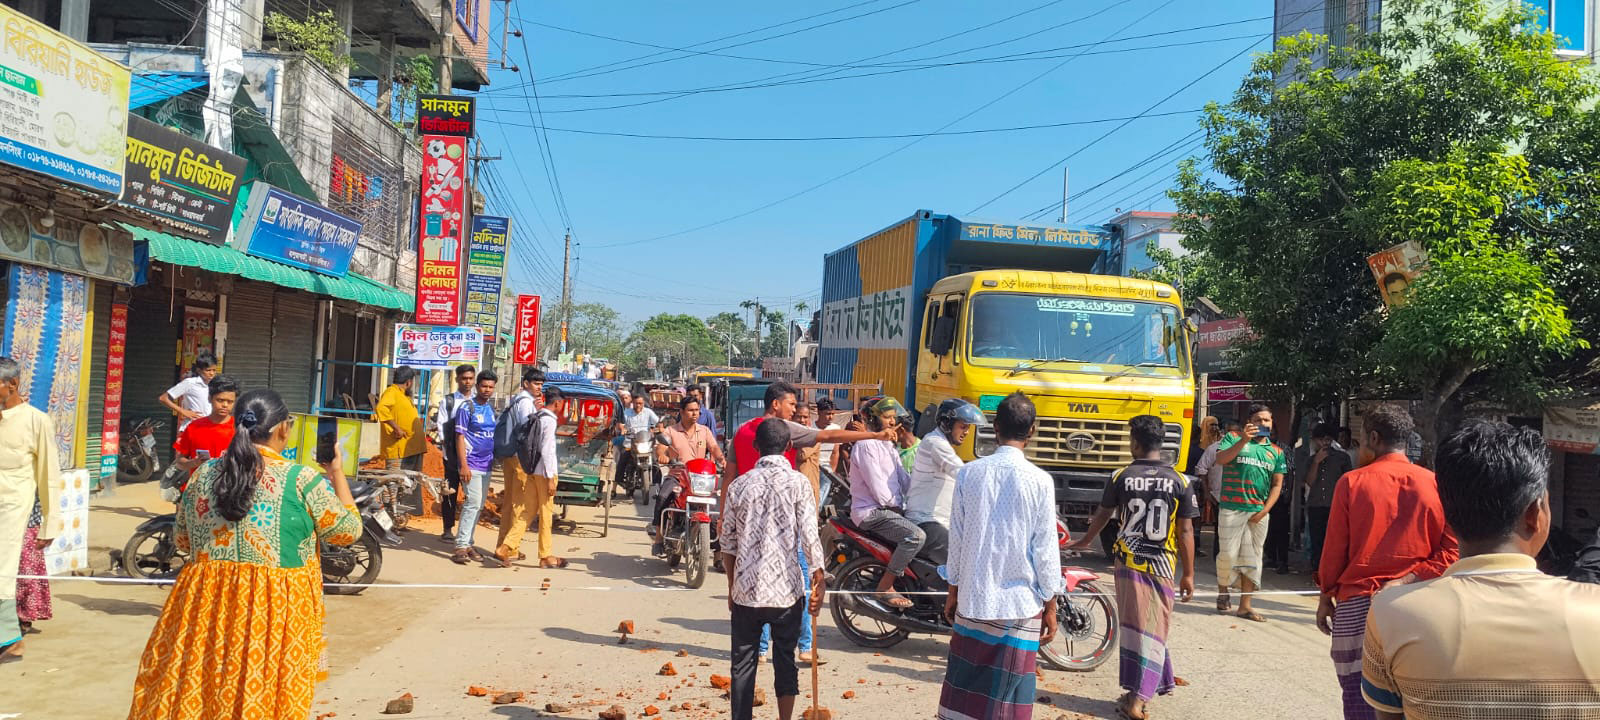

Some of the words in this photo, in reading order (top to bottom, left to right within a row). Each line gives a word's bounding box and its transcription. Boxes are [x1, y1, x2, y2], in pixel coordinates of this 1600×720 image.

[421, 98, 470, 116] সানমুন
[421, 115, 470, 132] ডিজিটাল
[125, 135, 177, 184] সানমুন
[175, 147, 237, 195] ডিজিটাল
[473, 228, 506, 245] মদিনা
[968, 225, 990, 238] রানা
[992, 224, 1013, 240] ফিড
[1045, 227, 1100, 246] লিমিটেড
[423, 260, 456, 276] লিমন
[420, 277, 458, 289] খেলাঘর
[402, 330, 427, 341] সিল
[449, 333, 463, 341] করা
[520, 306, 535, 353] যমুনা
[1068, 402, 1099, 413] TATA
[1124, 477, 1174, 493] ROFIK
[1124, 498, 1169, 541] 20
